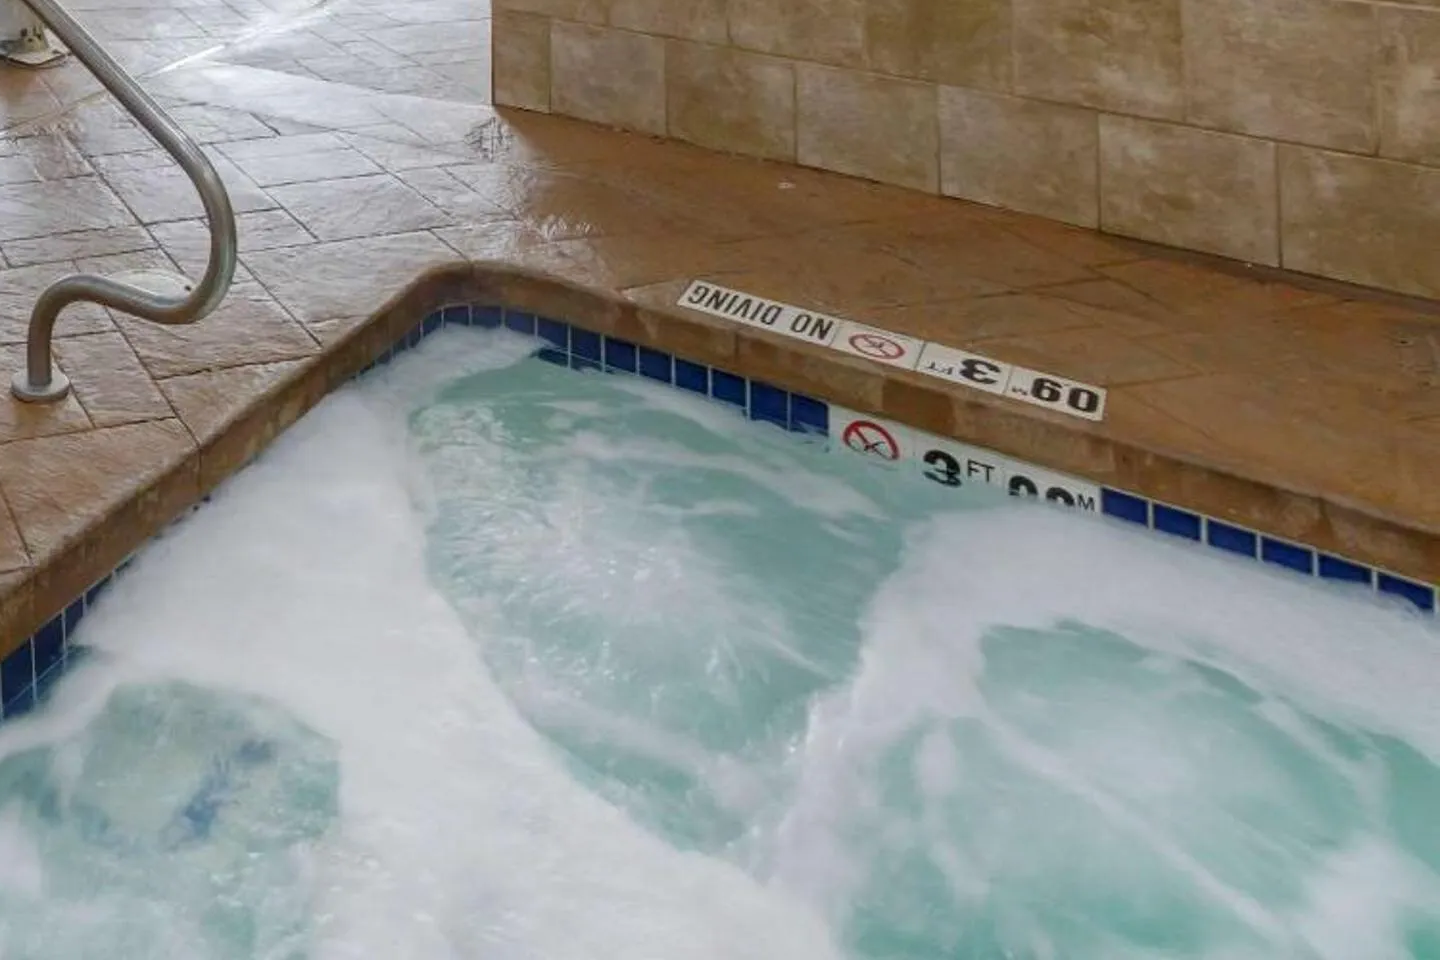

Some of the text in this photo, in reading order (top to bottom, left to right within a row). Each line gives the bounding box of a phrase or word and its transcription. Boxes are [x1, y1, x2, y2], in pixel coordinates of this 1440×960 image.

[687, 284, 784, 326] DIVING
[790, 313, 834, 341] NO
[960, 357, 1002, 385] 3
[922, 448, 962, 488] 3
[966, 458, 996, 483] FT
